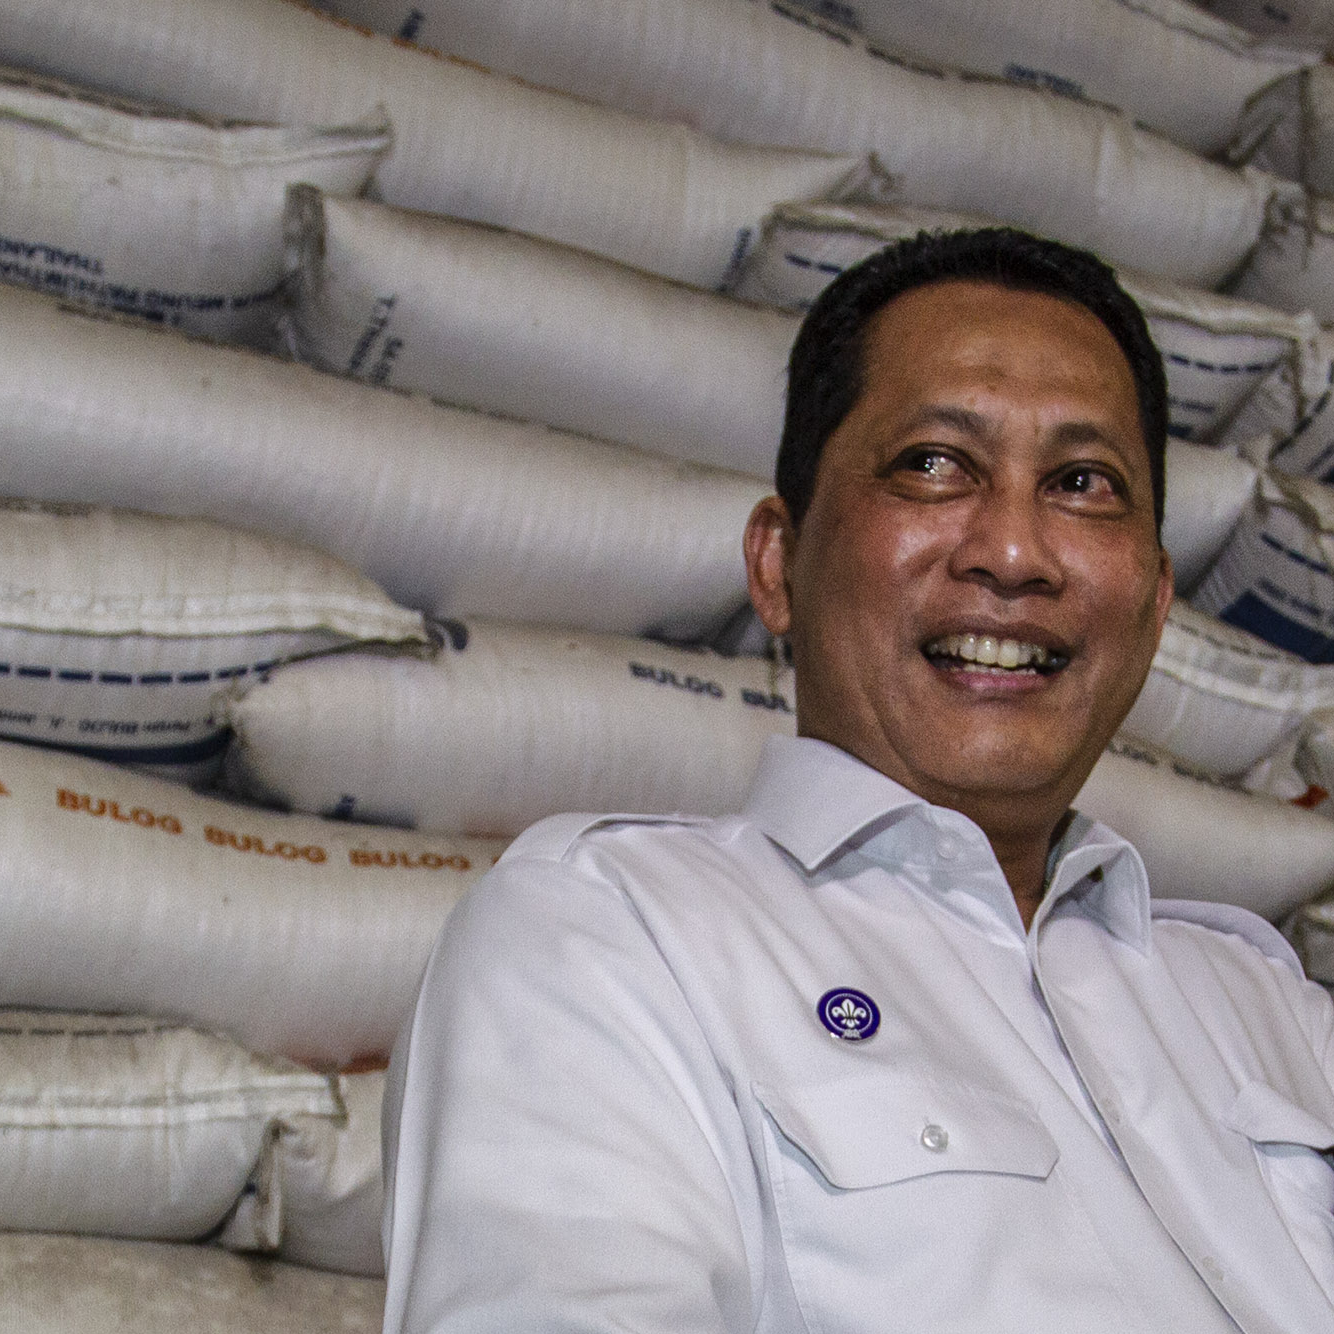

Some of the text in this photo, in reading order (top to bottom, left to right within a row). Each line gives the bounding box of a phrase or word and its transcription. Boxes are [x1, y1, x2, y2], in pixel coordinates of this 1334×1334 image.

[629, 661, 794, 713] BULOG BUL
[55, 787, 472, 873] BULOG BULOG BULOG
